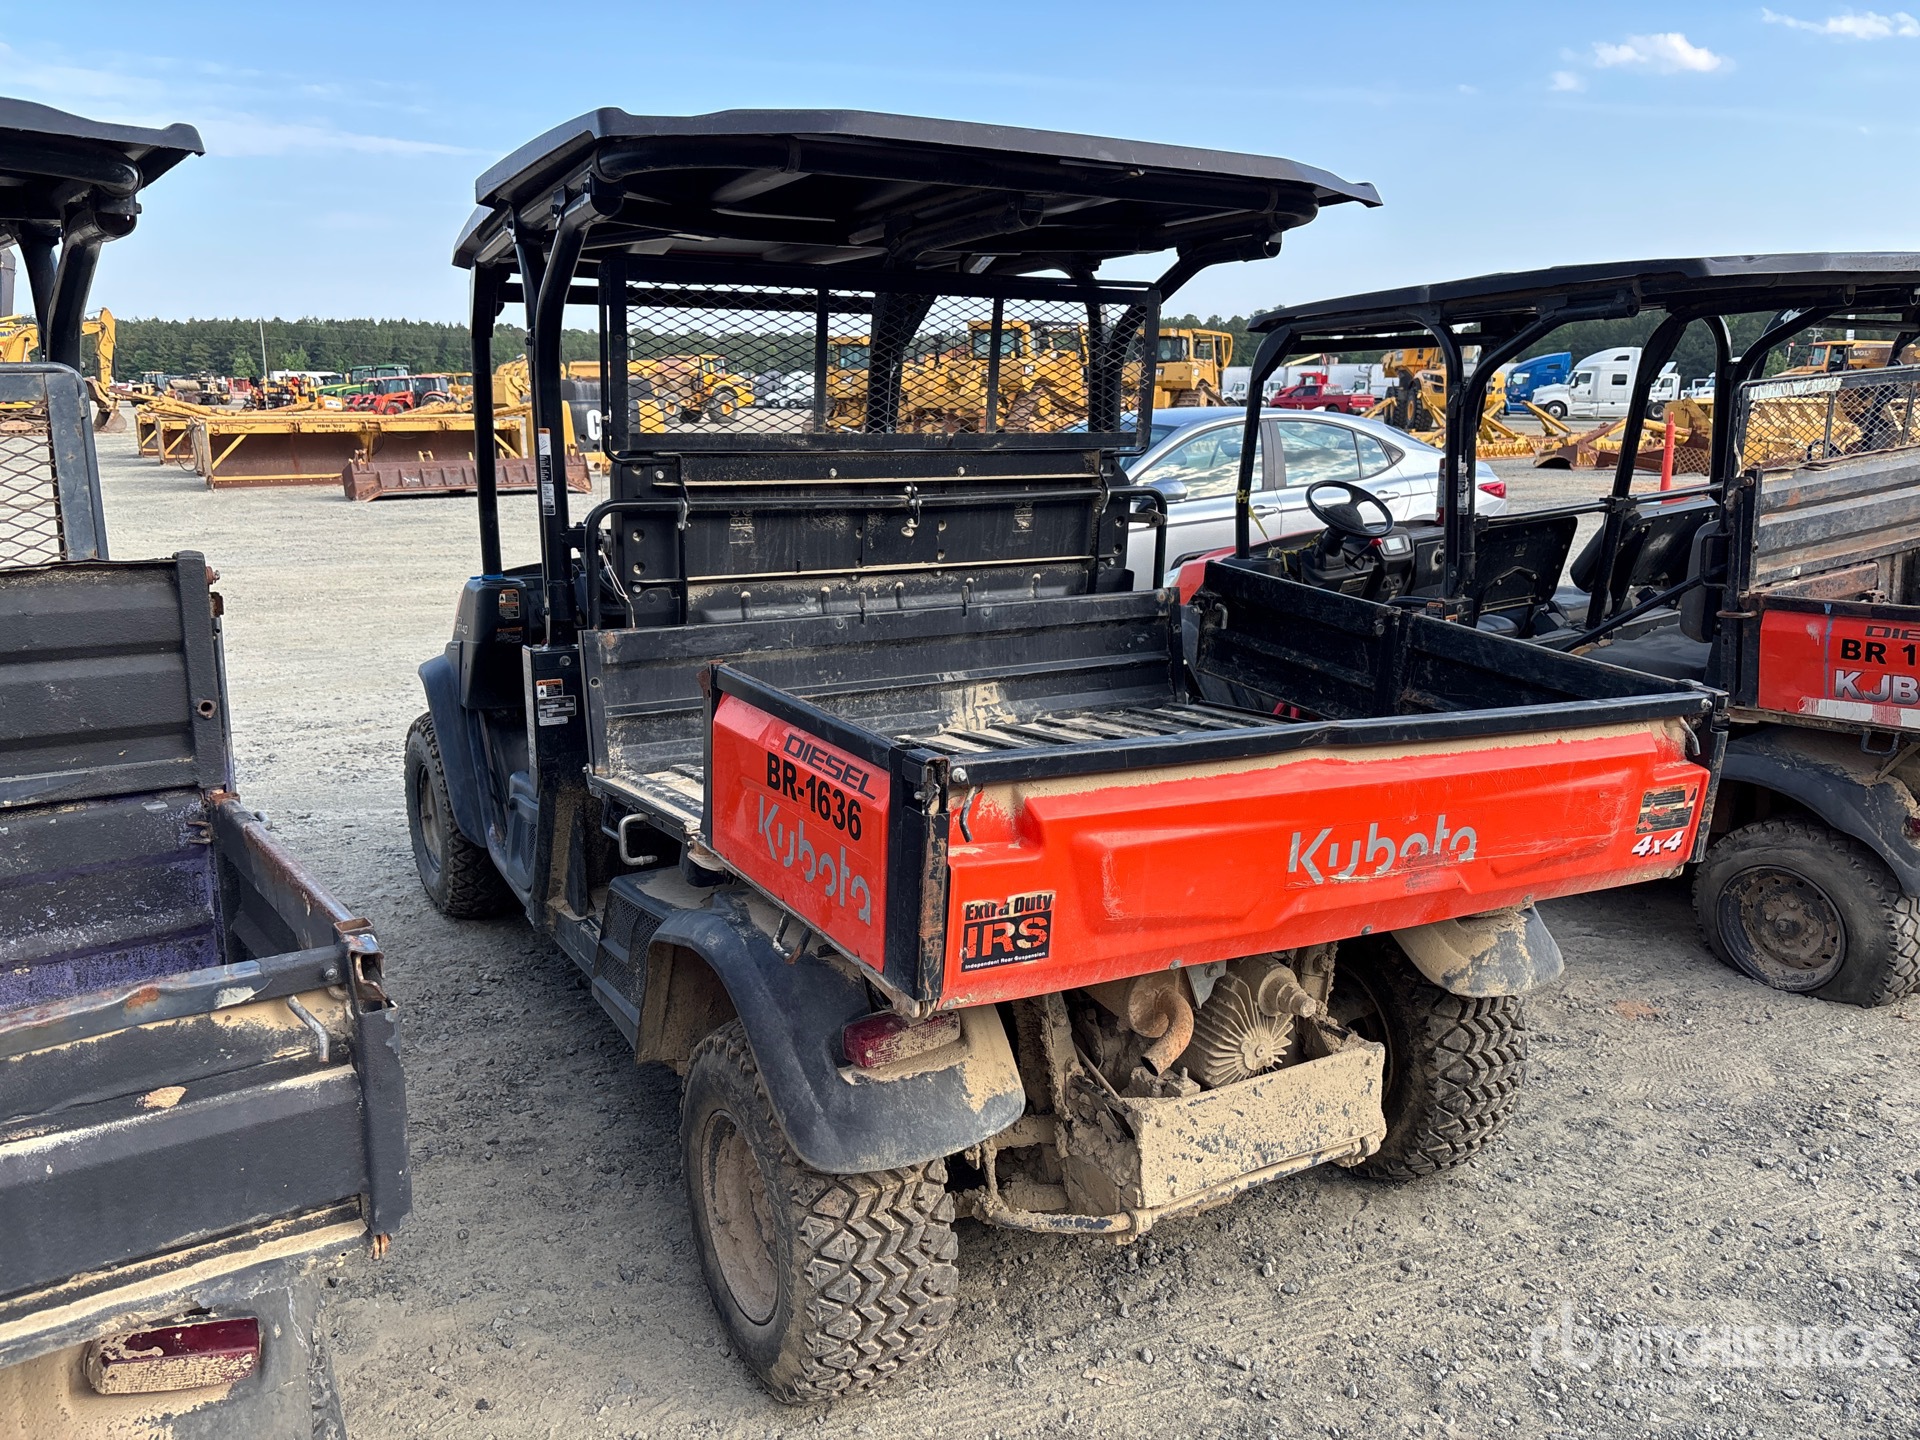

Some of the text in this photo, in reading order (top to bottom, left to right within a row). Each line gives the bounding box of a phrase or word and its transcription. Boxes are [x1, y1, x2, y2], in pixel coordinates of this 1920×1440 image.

[1841, 638, 1916, 666] BR 1
[784, 733, 876, 801] DIESEL
[767, 751, 862, 841] BR-1636
[758, 795, 871, 926] Kubota
[1287, 814, 1477, 885] Kubota
[1631, 830, 1685, 857] 4x4
[1014, 893, 1053, 914] Duty
[966, 917, 1048, 959] IRS
[965, 951, 1046, 970] Independent Rear Suspension
